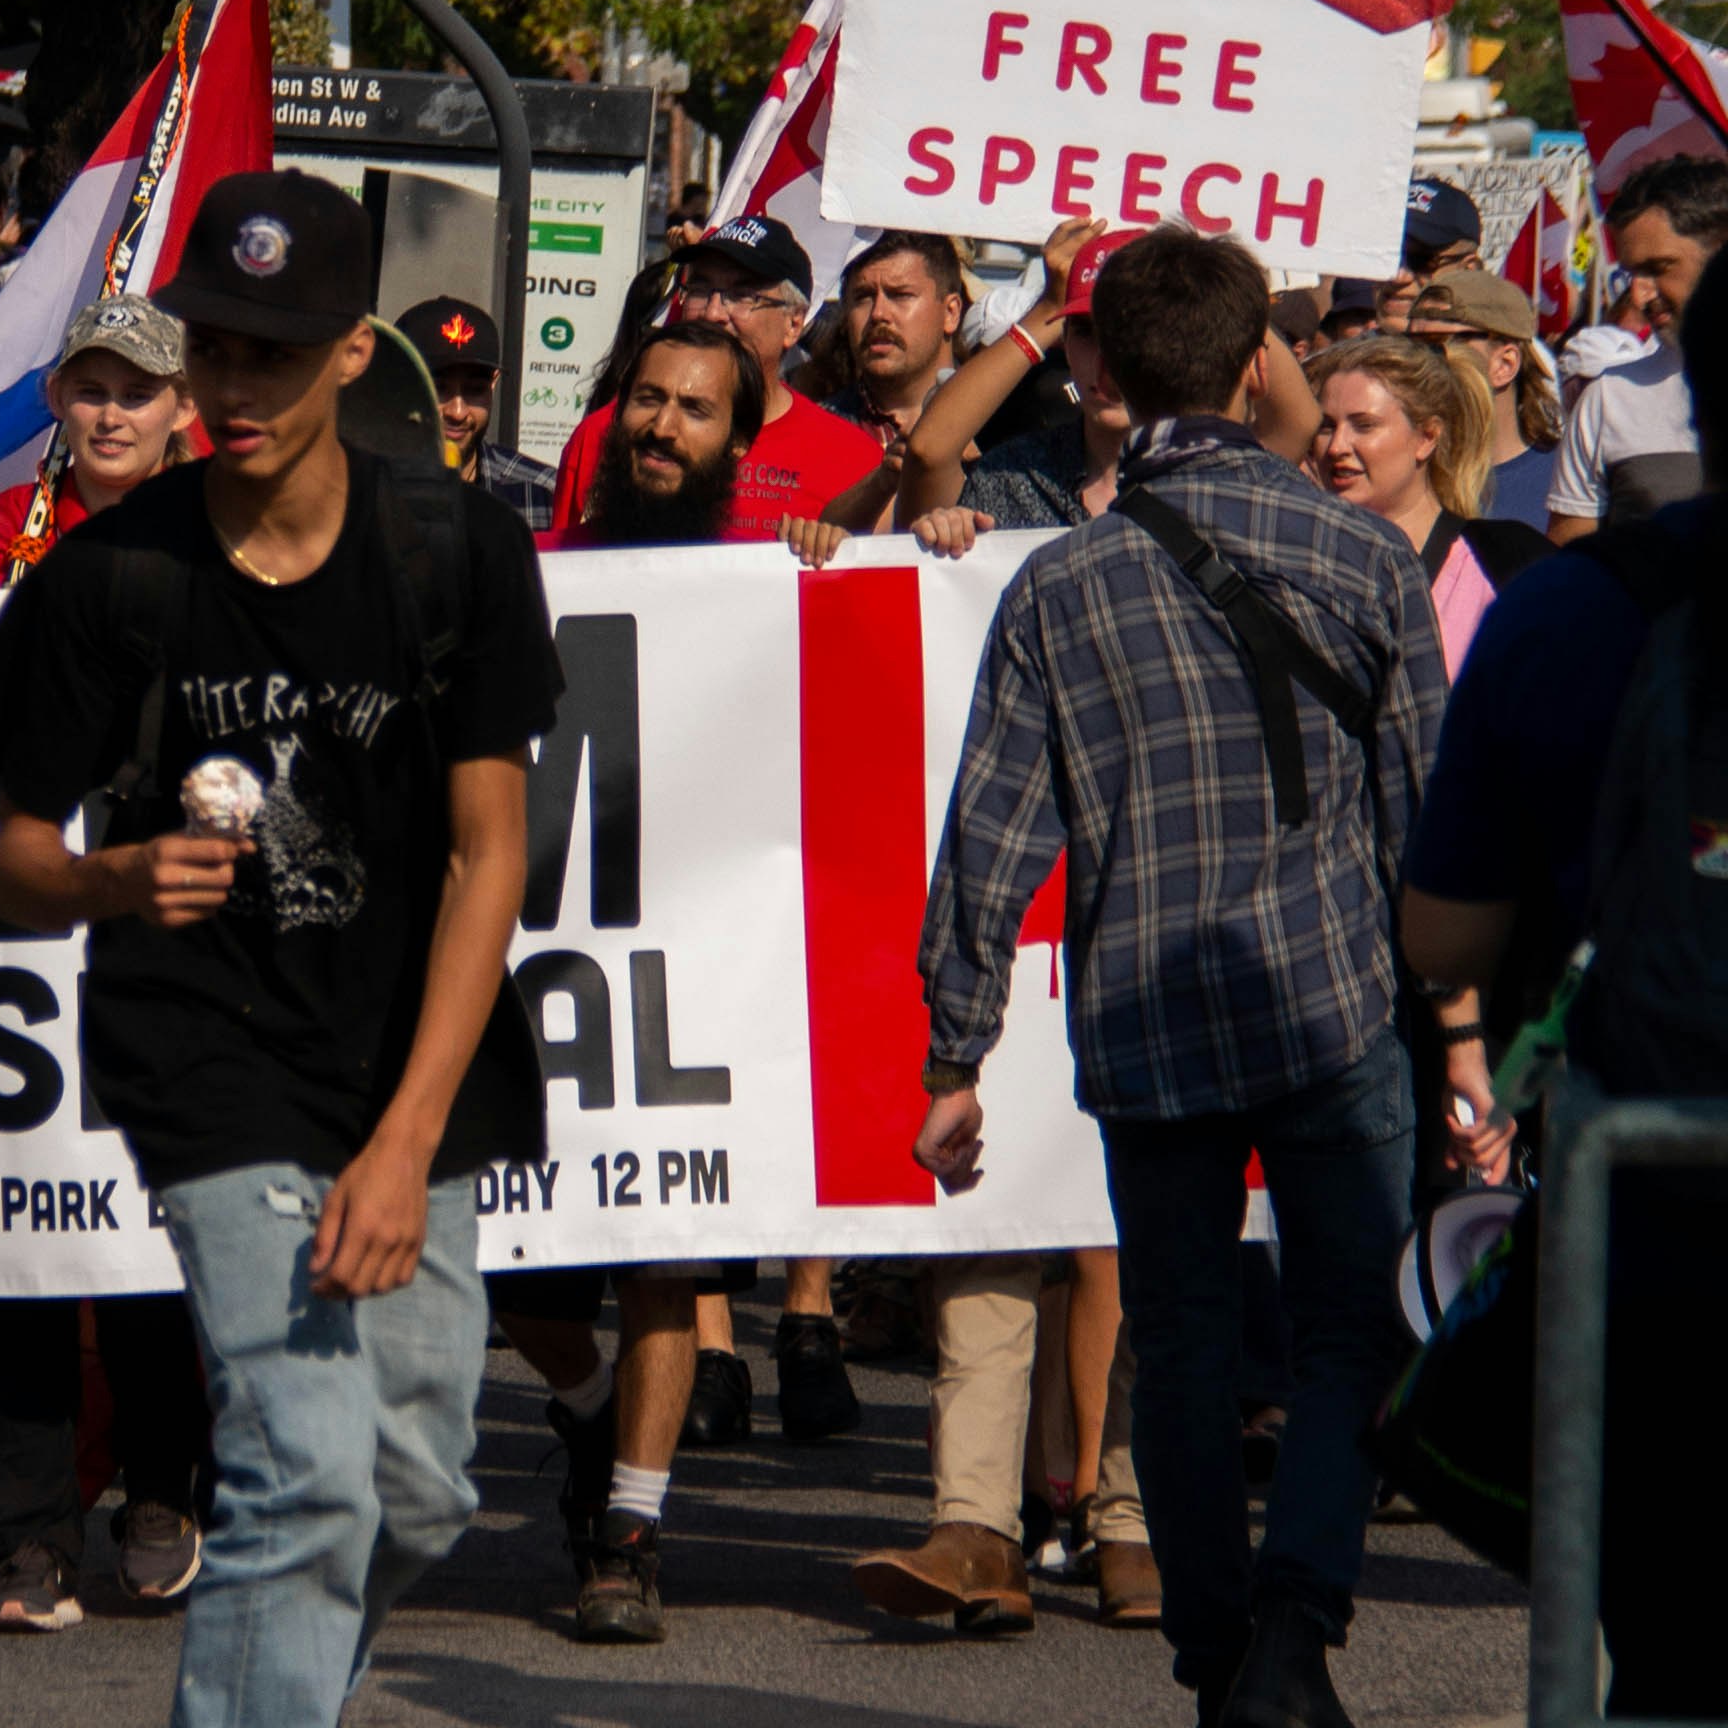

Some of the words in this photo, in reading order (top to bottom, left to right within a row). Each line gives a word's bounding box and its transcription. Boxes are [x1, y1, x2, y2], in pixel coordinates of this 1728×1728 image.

[981, 11, 1262, 113] FREE
[272, 78, 304, 98] en
[310, 76, 333, 98] St
[339, 77, 360, 100] W
[365, 80, 382, 102] &
[272, 103, 322, 126] dina
[327, 105, 368, 129] Ave
[904, 127, 1324, 247] SPEECH
[556, 199, 605, 214] CITY
[525, 276, 597, 297] DING
[547, 325, 567, 343] 3
[529, 361, 580, 376] RETURN
[755, 464, 801, 489] CODE
[0, 1176, 120, 1233] PARK
[590, 1150, 642, 1208] 12
[657, 1149, 730, 1206] PM
